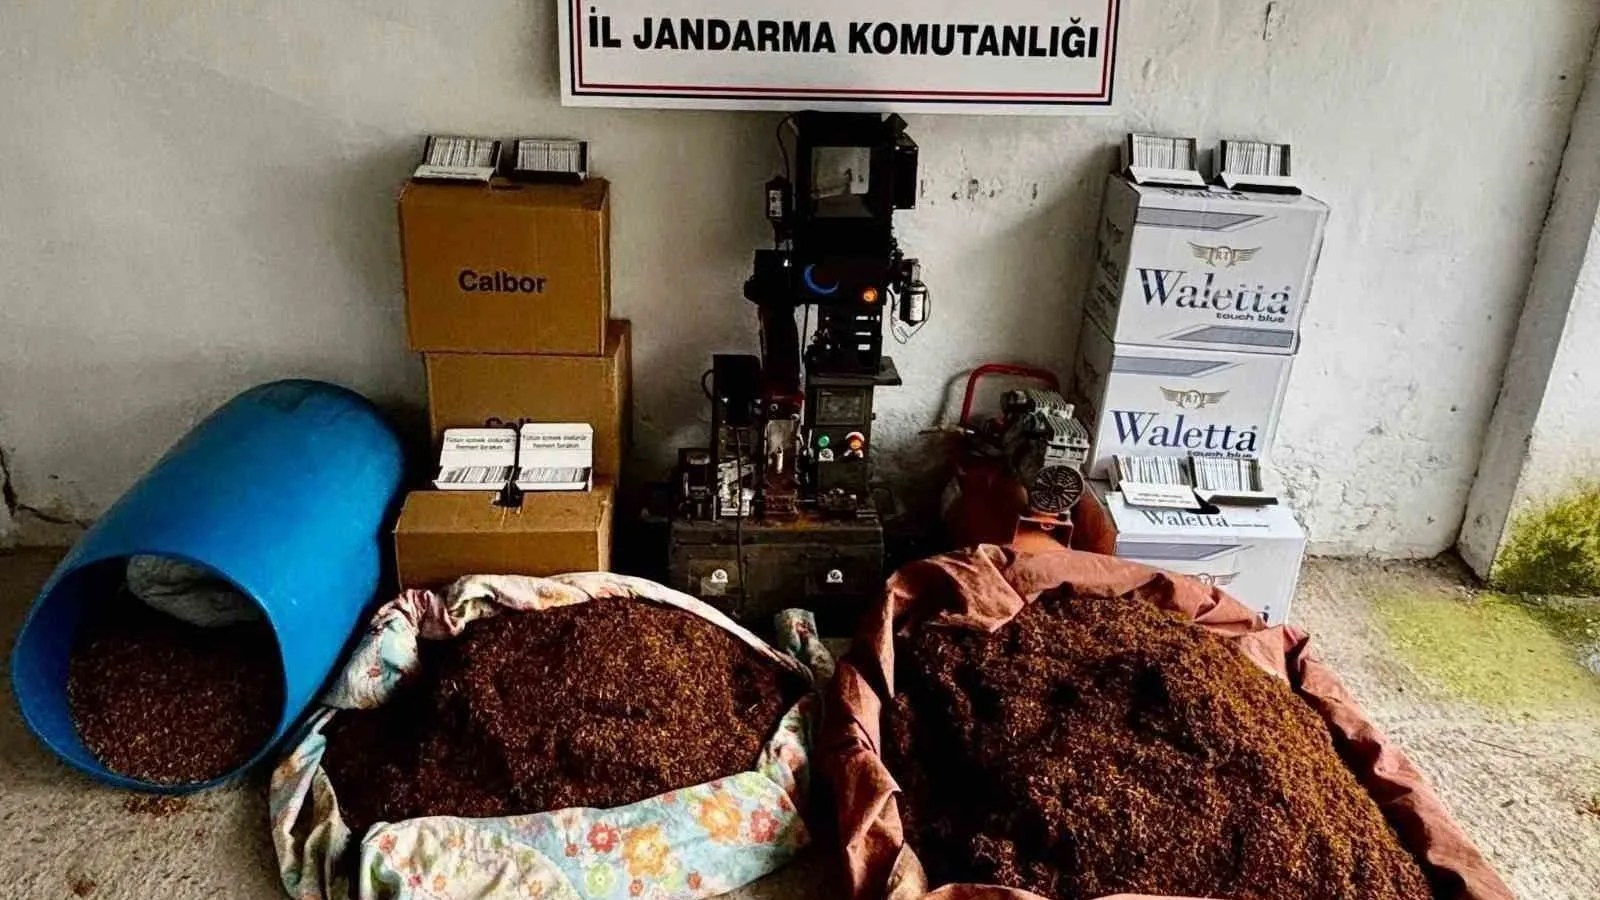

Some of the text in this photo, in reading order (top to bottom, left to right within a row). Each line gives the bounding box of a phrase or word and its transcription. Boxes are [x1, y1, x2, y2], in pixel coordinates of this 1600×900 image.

[588, 6, 1100, 59] İL JANDARMA KOMUTANLIĞI
[458, 269, 548, 293] Calbor
[1136, 267, 1290, 315] Waletta
[1216, 312, 1285, 323] touch blue
[1110, 410, 1257, 453] Waletta
[1141, 509, 1230, 528] Waletta
